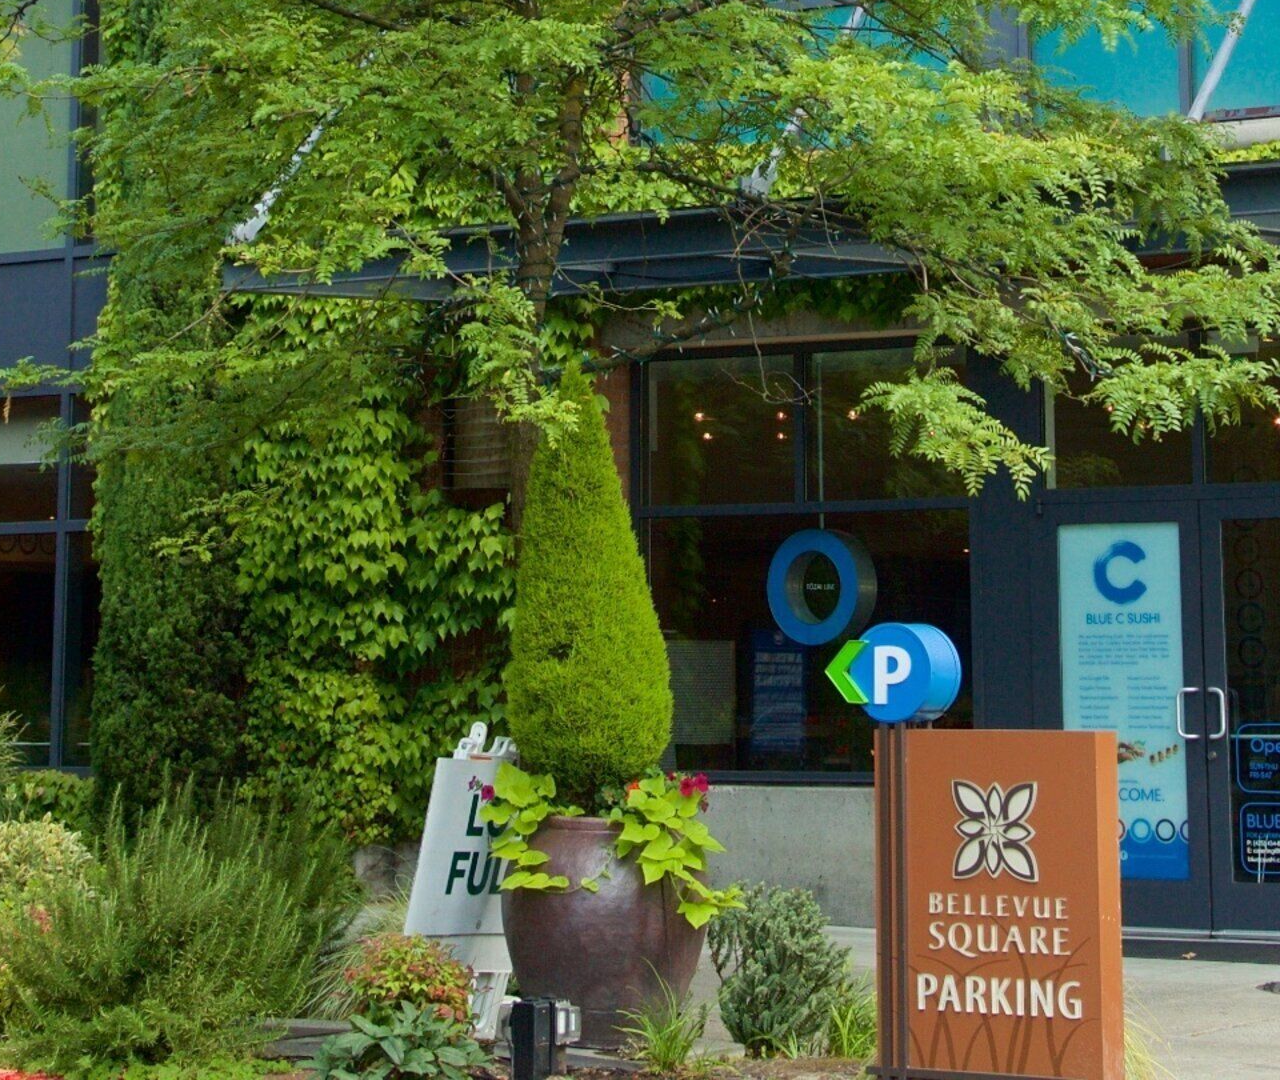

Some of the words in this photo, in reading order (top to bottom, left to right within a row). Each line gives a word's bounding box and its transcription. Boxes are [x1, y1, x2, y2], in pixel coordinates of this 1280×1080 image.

[1093, 539, 1148, 605] C
[1086, 613, 1113, 625] BLUE
[1115, 612, 1125, 625] C
[1127, 612, 1160, 624] SUSHI
[874, 645, 912, 705] P
[928, 892, 1069, 920] BELLEVUE
[927, 921, 1071, 958] SQUARE
[917, 973, 1083, 1020] PARKING
